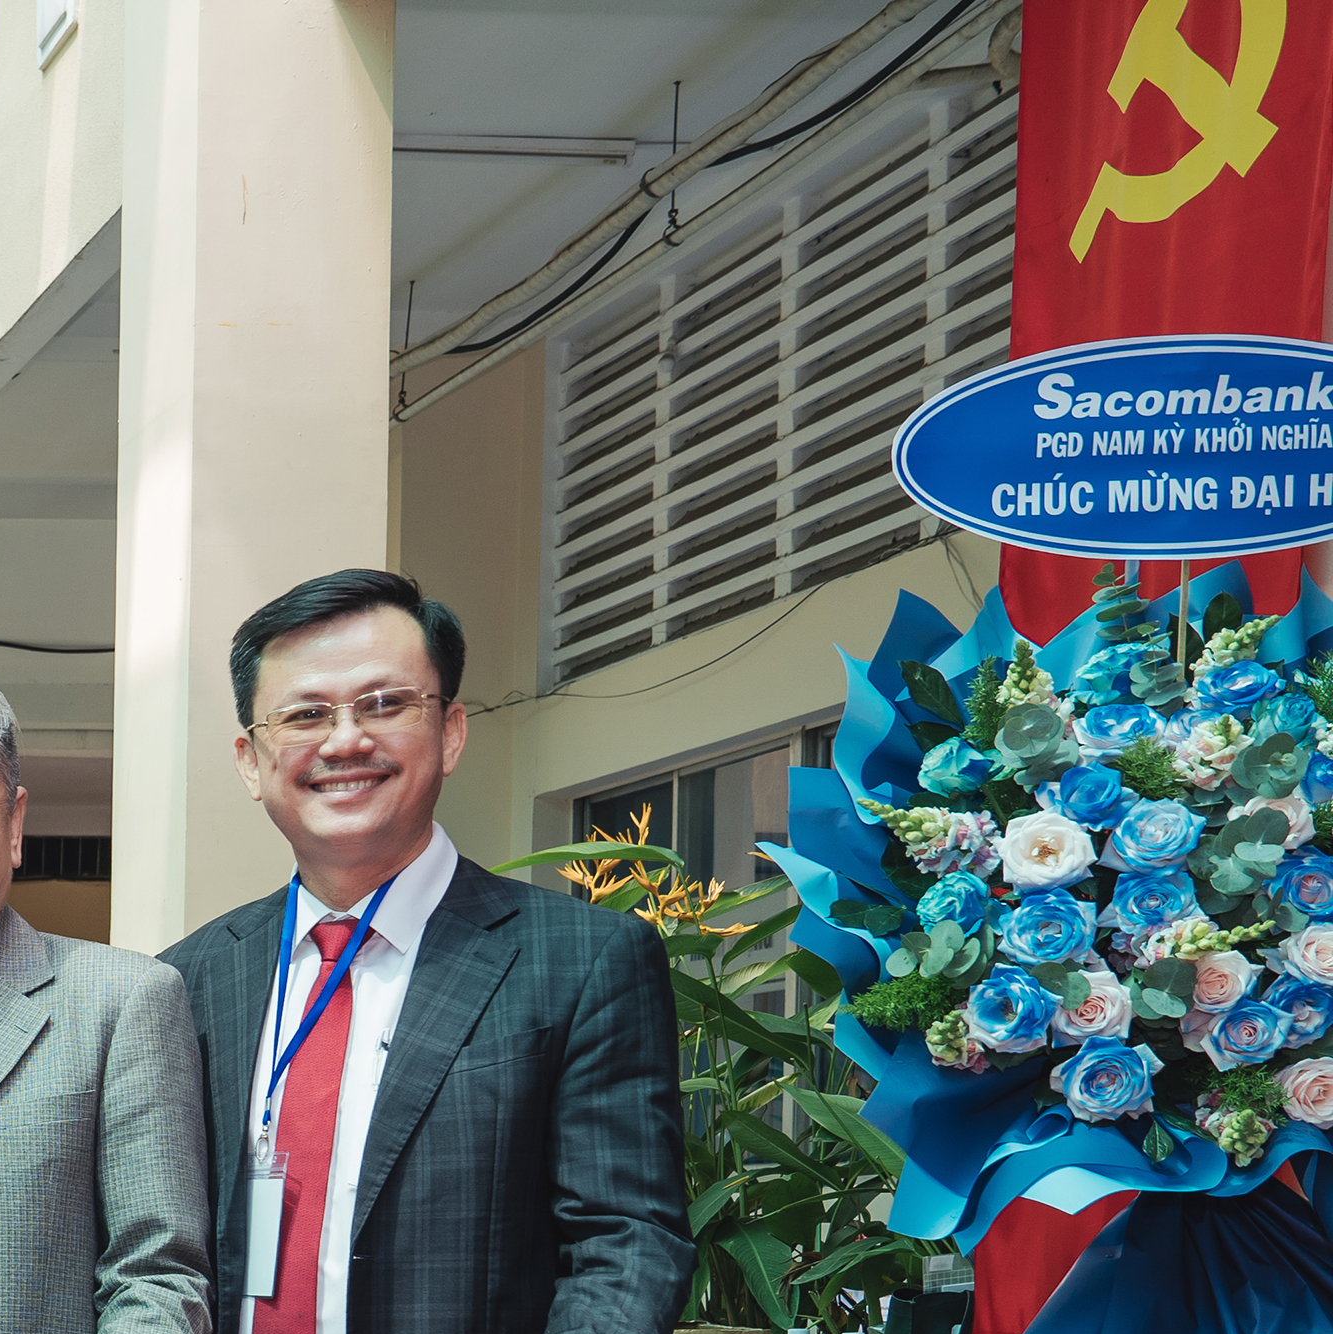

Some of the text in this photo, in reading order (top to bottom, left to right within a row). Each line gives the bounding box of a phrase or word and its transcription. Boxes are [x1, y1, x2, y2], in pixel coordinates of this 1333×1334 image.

[1033, 371, 1333, 420] Sacombank
[1036, 417, 1333, 458] PGD NAM KỲ KHỞI NGHĨA
[991, 470, 1333, 518] CHÚC MỪNG ĐẠI H
